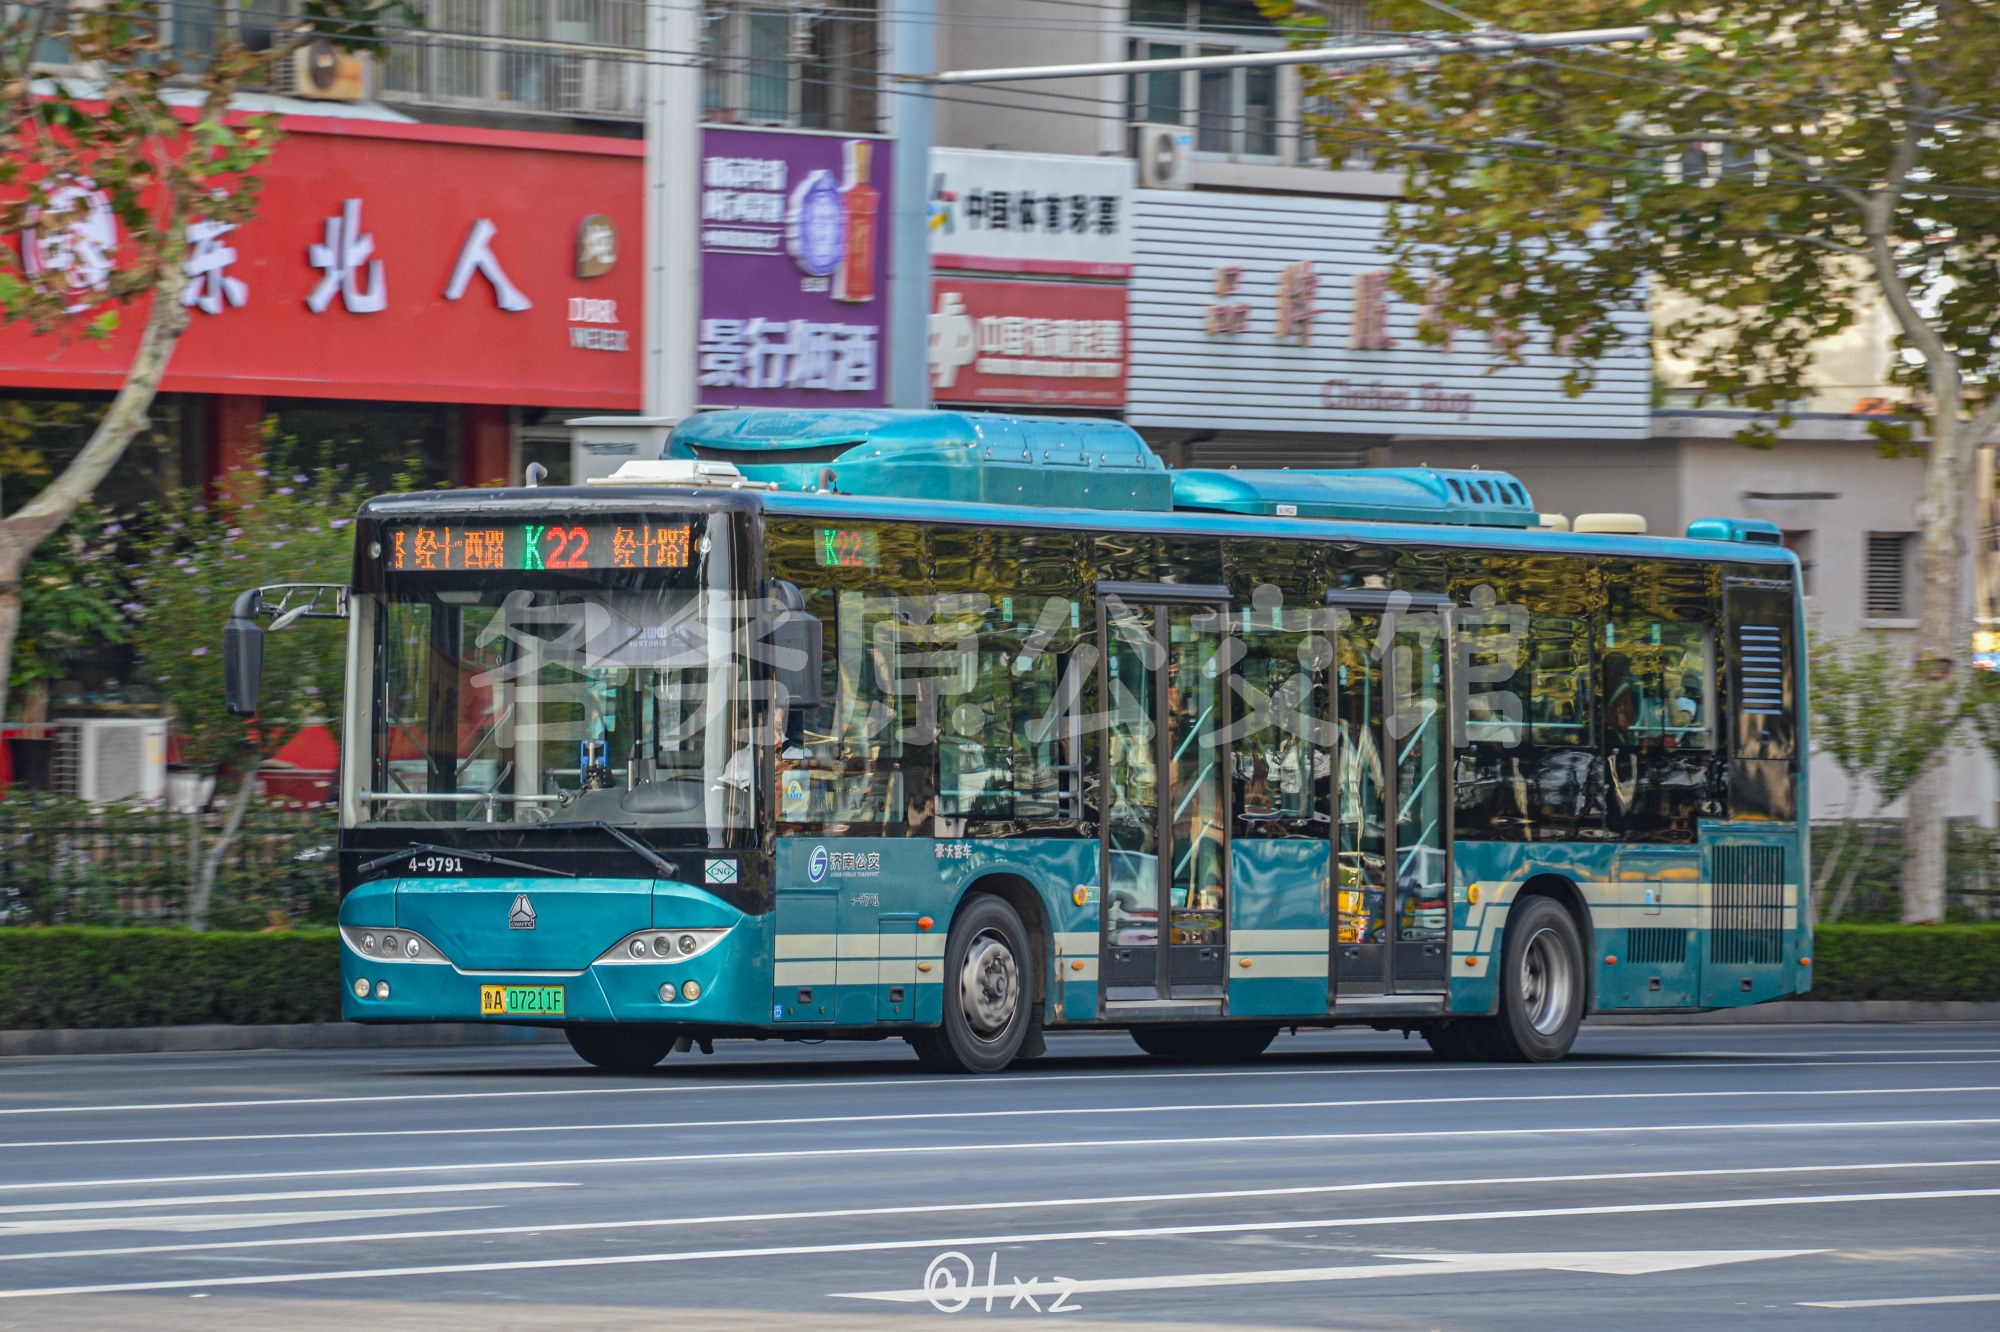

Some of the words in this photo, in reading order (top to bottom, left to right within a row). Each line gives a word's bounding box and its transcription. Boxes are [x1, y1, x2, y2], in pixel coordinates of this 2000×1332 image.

[525, 525, 589, 569] K22
[824, 529, 862, 566] K22
[935, 843, 972, 859] 豪沃客车
[408, 857, 463, 872] 4-9791
[829, 852, 880, 870] 济南公交
[710, 867, 731, 876] CNG
